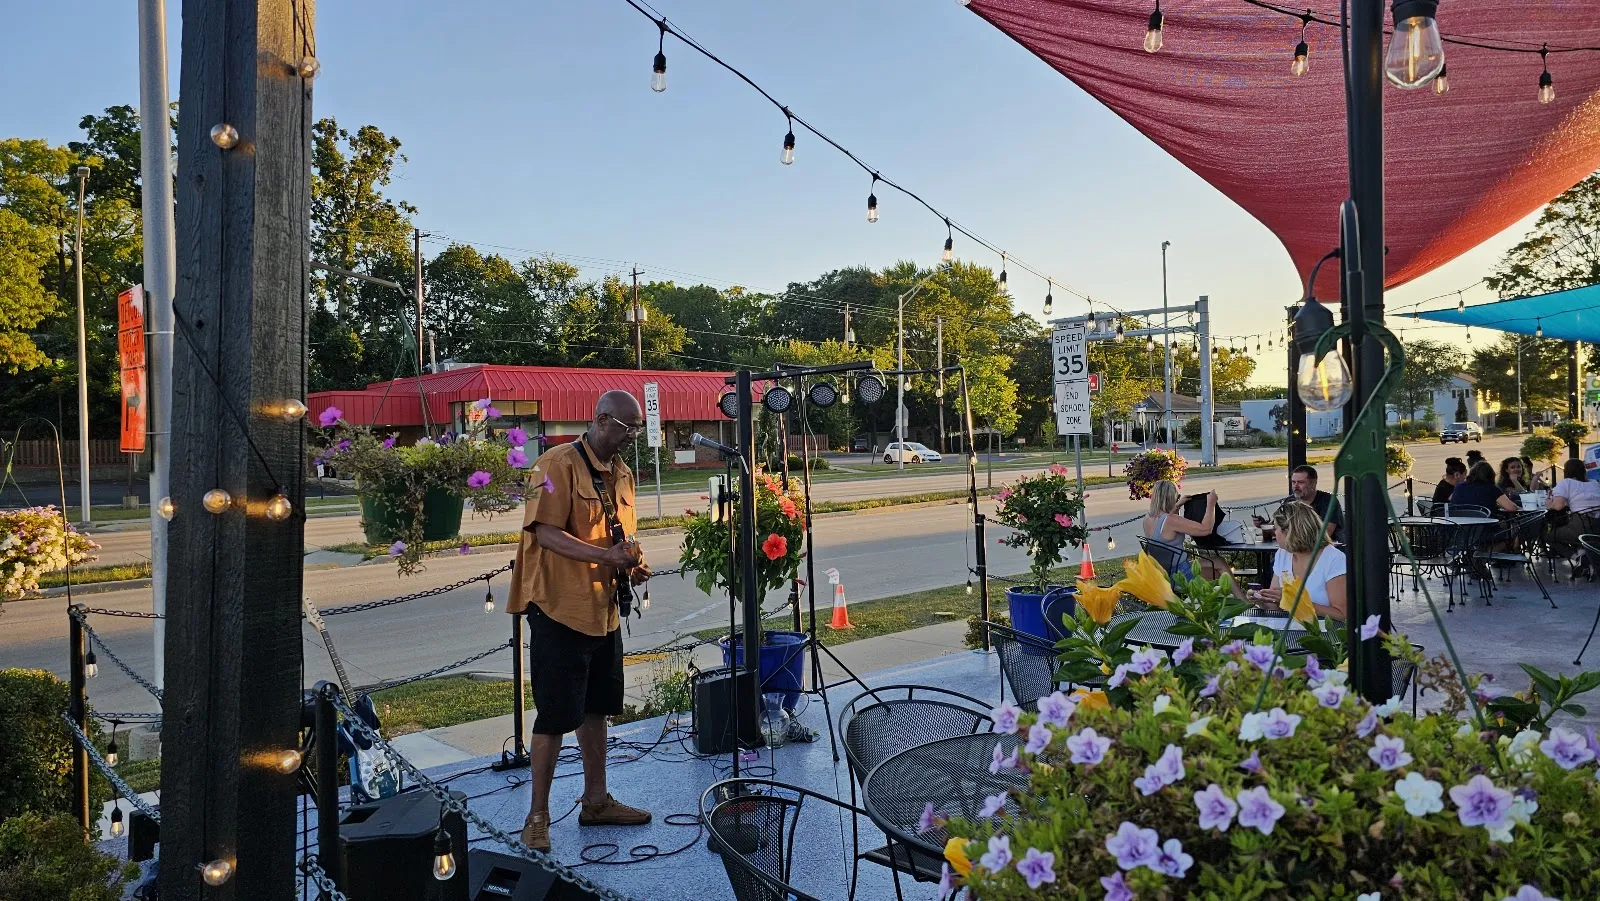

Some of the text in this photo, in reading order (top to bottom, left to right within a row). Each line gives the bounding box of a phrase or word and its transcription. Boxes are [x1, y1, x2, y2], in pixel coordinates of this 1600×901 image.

[1054, 332, 1083, 344] SPEED
[1058, 344, 1080, 355] LIMIT
[1057, 354, 1084, 376] 35
[1065, 391, 1079, 400] END
[646, 399, 658, 412] 35
[1060, 403, 1086, 413] SCHOOL
[1066, 416, 1082, 425] ZONE
